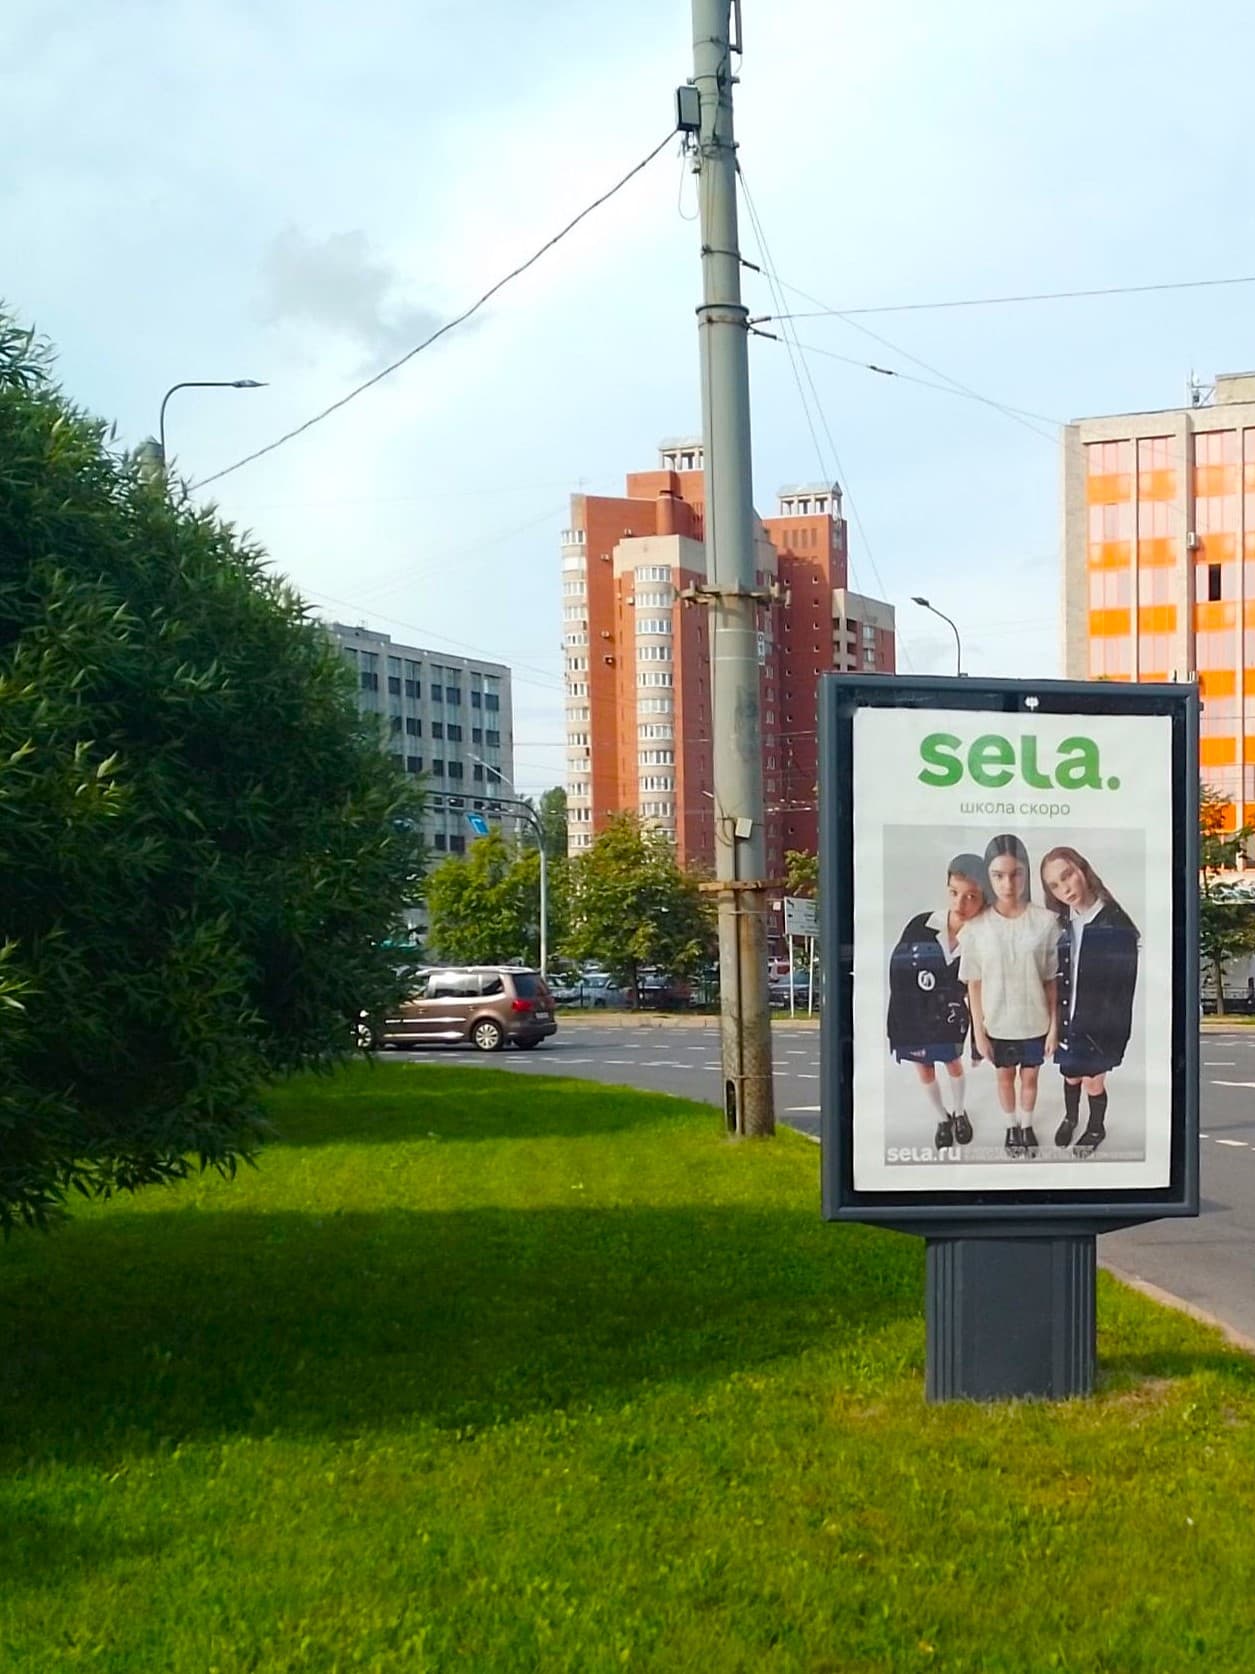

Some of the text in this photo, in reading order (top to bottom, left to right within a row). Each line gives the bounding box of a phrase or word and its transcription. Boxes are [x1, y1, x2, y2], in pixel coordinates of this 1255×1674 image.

[918, 733, 1120, 790] sela.
[960, 801, 1071, 818] школа скоро
[887, 1146, 961, 1161] sela.ru
